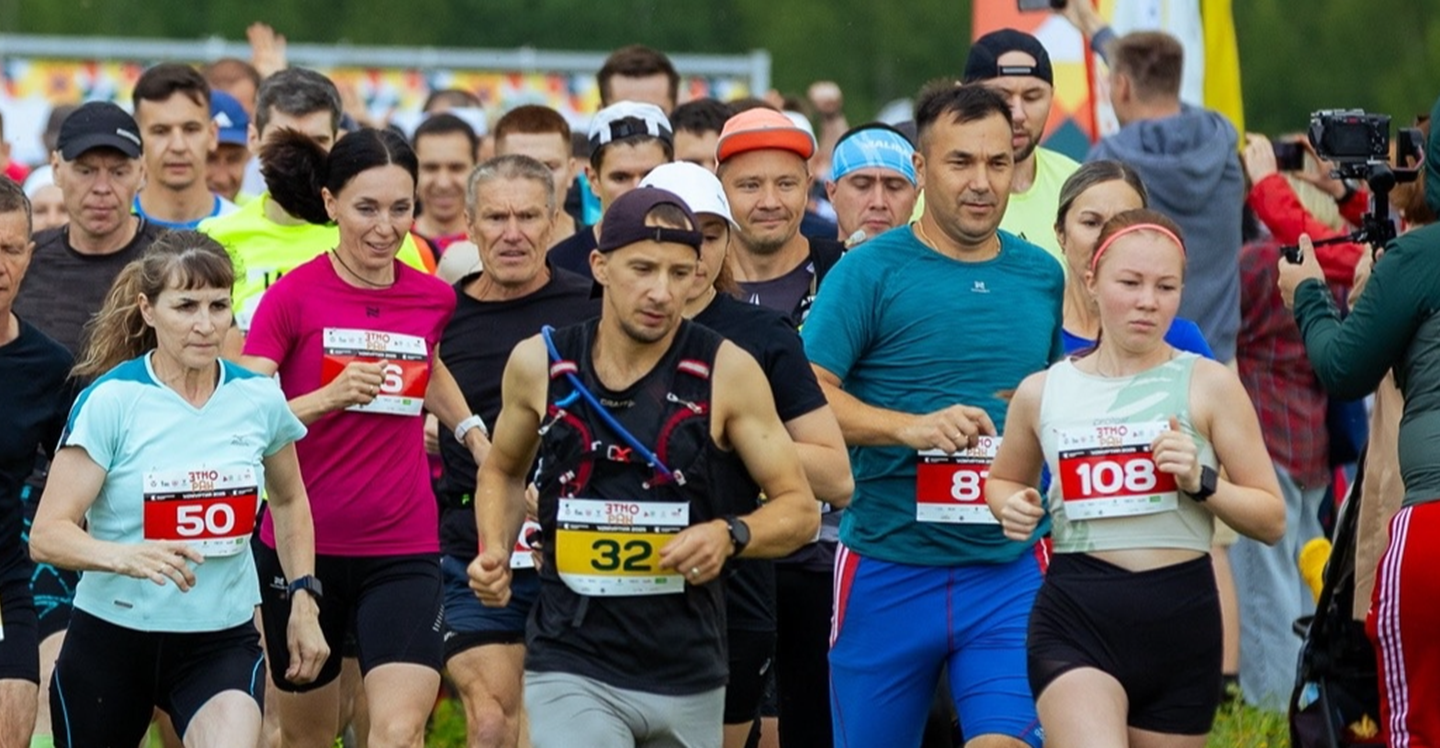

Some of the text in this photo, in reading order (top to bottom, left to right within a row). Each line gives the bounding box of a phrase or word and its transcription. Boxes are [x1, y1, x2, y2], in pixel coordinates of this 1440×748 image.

[1075, 458, 1157, 496] 108
[176, 503, 235, 537] 50
[591, 539, 653, 572] 32
